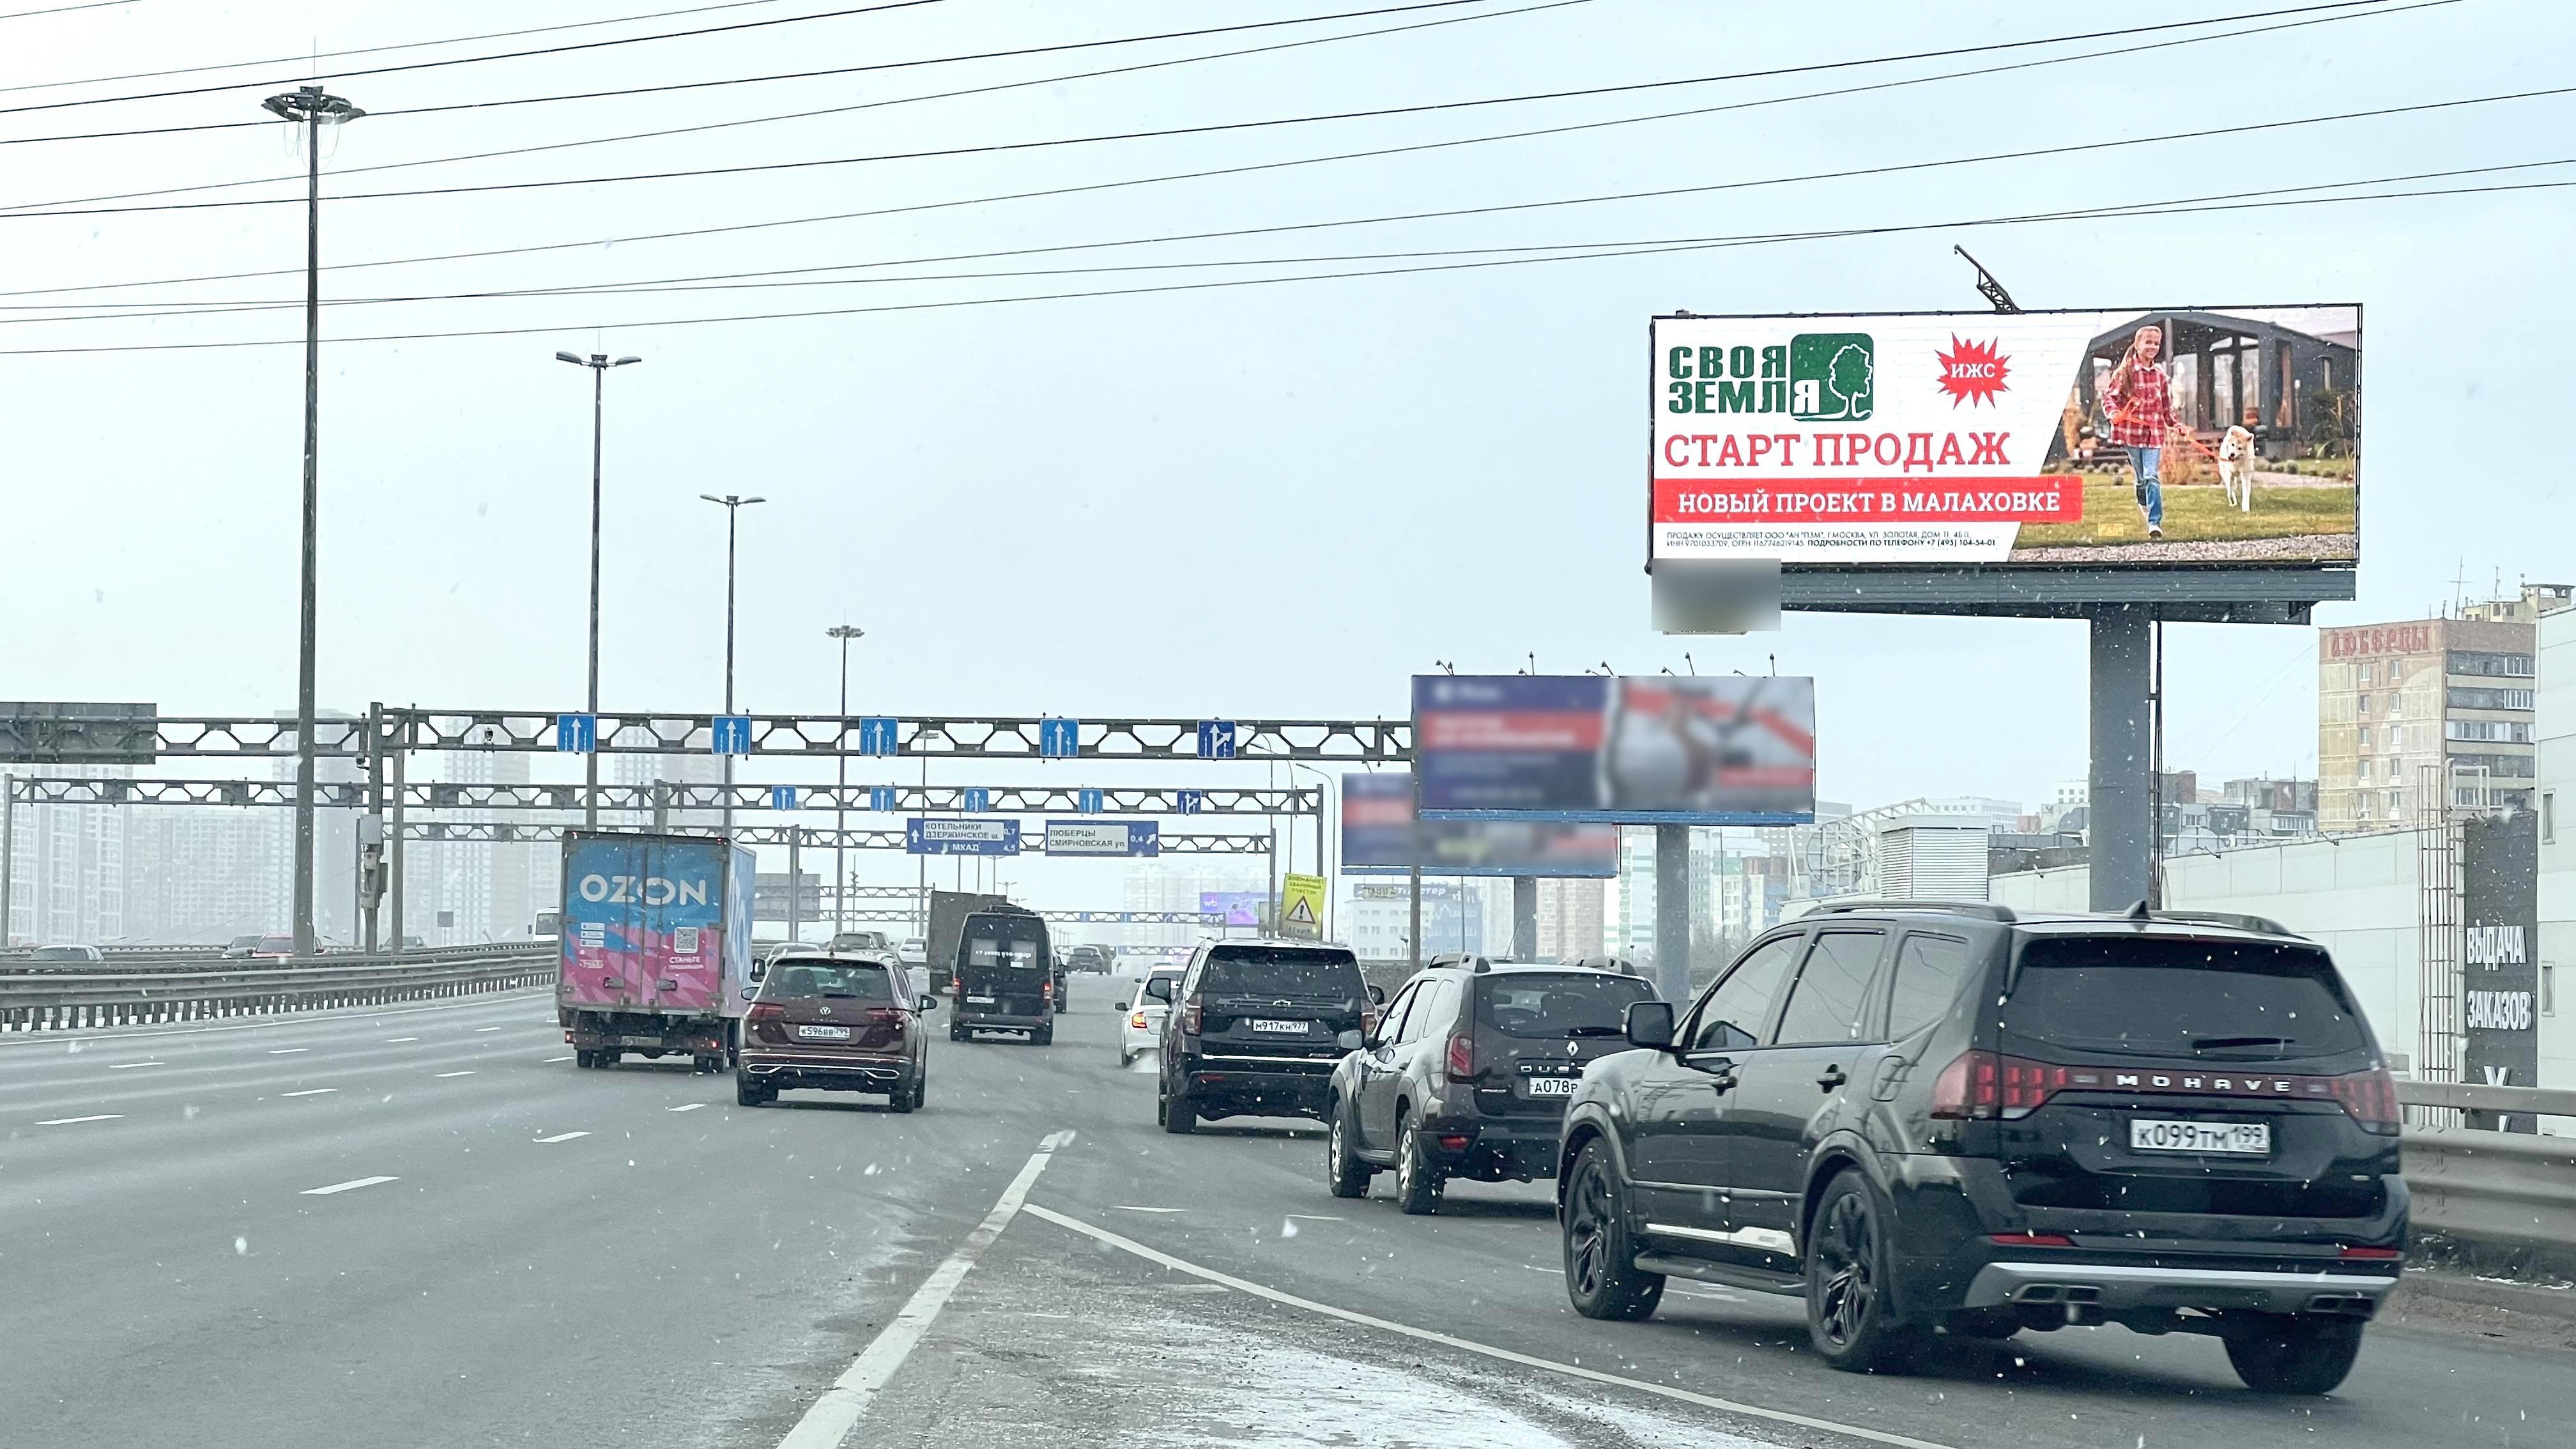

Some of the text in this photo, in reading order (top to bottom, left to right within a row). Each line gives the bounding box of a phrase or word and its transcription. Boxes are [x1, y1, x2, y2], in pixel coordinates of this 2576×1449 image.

[1669, 346, 1786, 379] СВОЯ
[1951, 363, 1995, 378] ИЖС
[1669, 379, 1820, 414] ЗЕМЛЯ
[1664, 433, 2011, 472] СТАРТ ПРОДАЖ
[1678, 488, 2060, 513] НОВЫЙ ПРОЕКТ В МАЛАХОВКЕ
[1921, 531, 1940, 539] ДОМ
[1050, 839, 1113, 847] СМИРНОВСКАЯ
[1130, 835, 1144, 843] 0,4
[953, 843, 979, 852] МКАД
[1003, 844, 1016, 852] 4,5
[580, 874, 706, 906] OZON
[1204, 898, 1217, 907] wb
[2467, 926, 2527, 970] ВЫДАЧА
[2467, 990, 2531, 1031] ЗАКАЗОВ
[2116, 1075, 2290, 1091] MOHAVE
